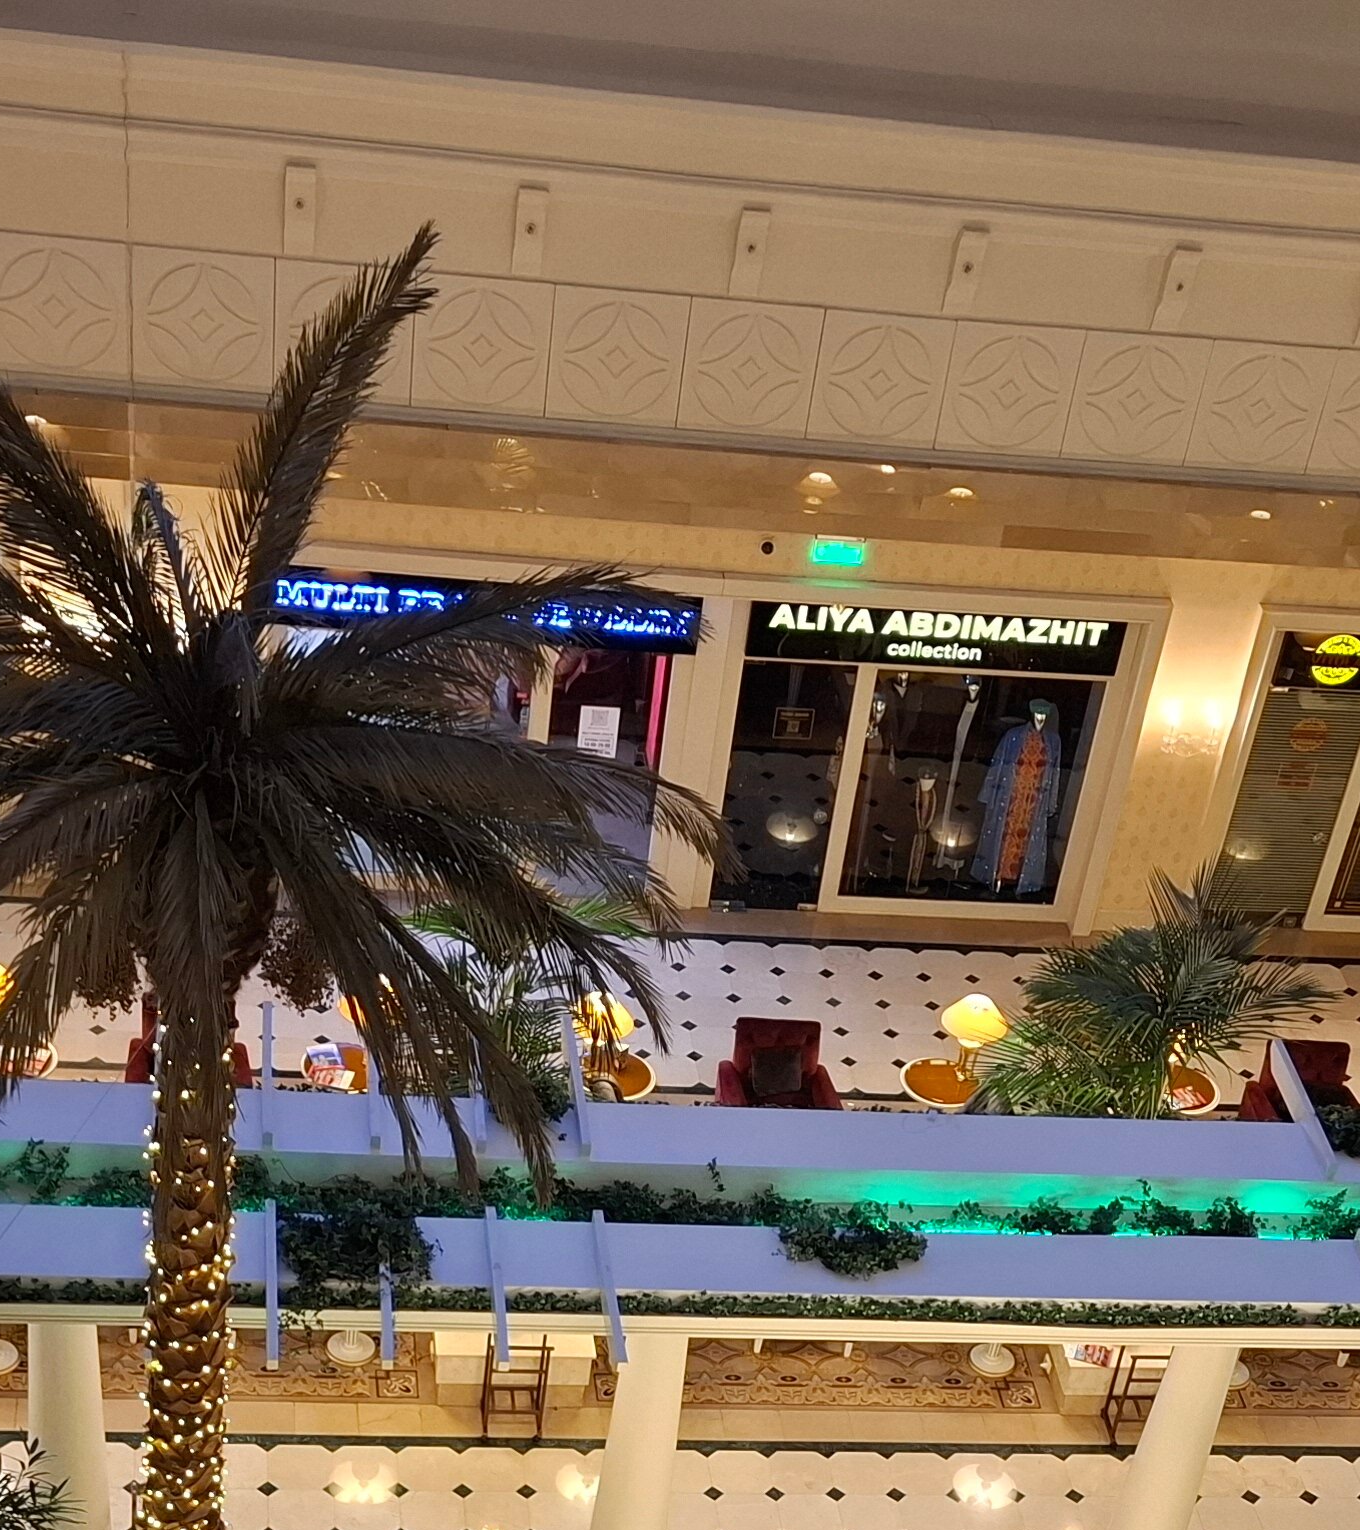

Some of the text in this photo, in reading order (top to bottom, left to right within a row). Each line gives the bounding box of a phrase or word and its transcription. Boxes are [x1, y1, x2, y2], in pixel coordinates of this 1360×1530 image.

[275, 579, 390, 614] MULTI
[768, 603, 1109, 647] ALIYA ABDIMAZHIT
[886, 640, 982, 661] collection
